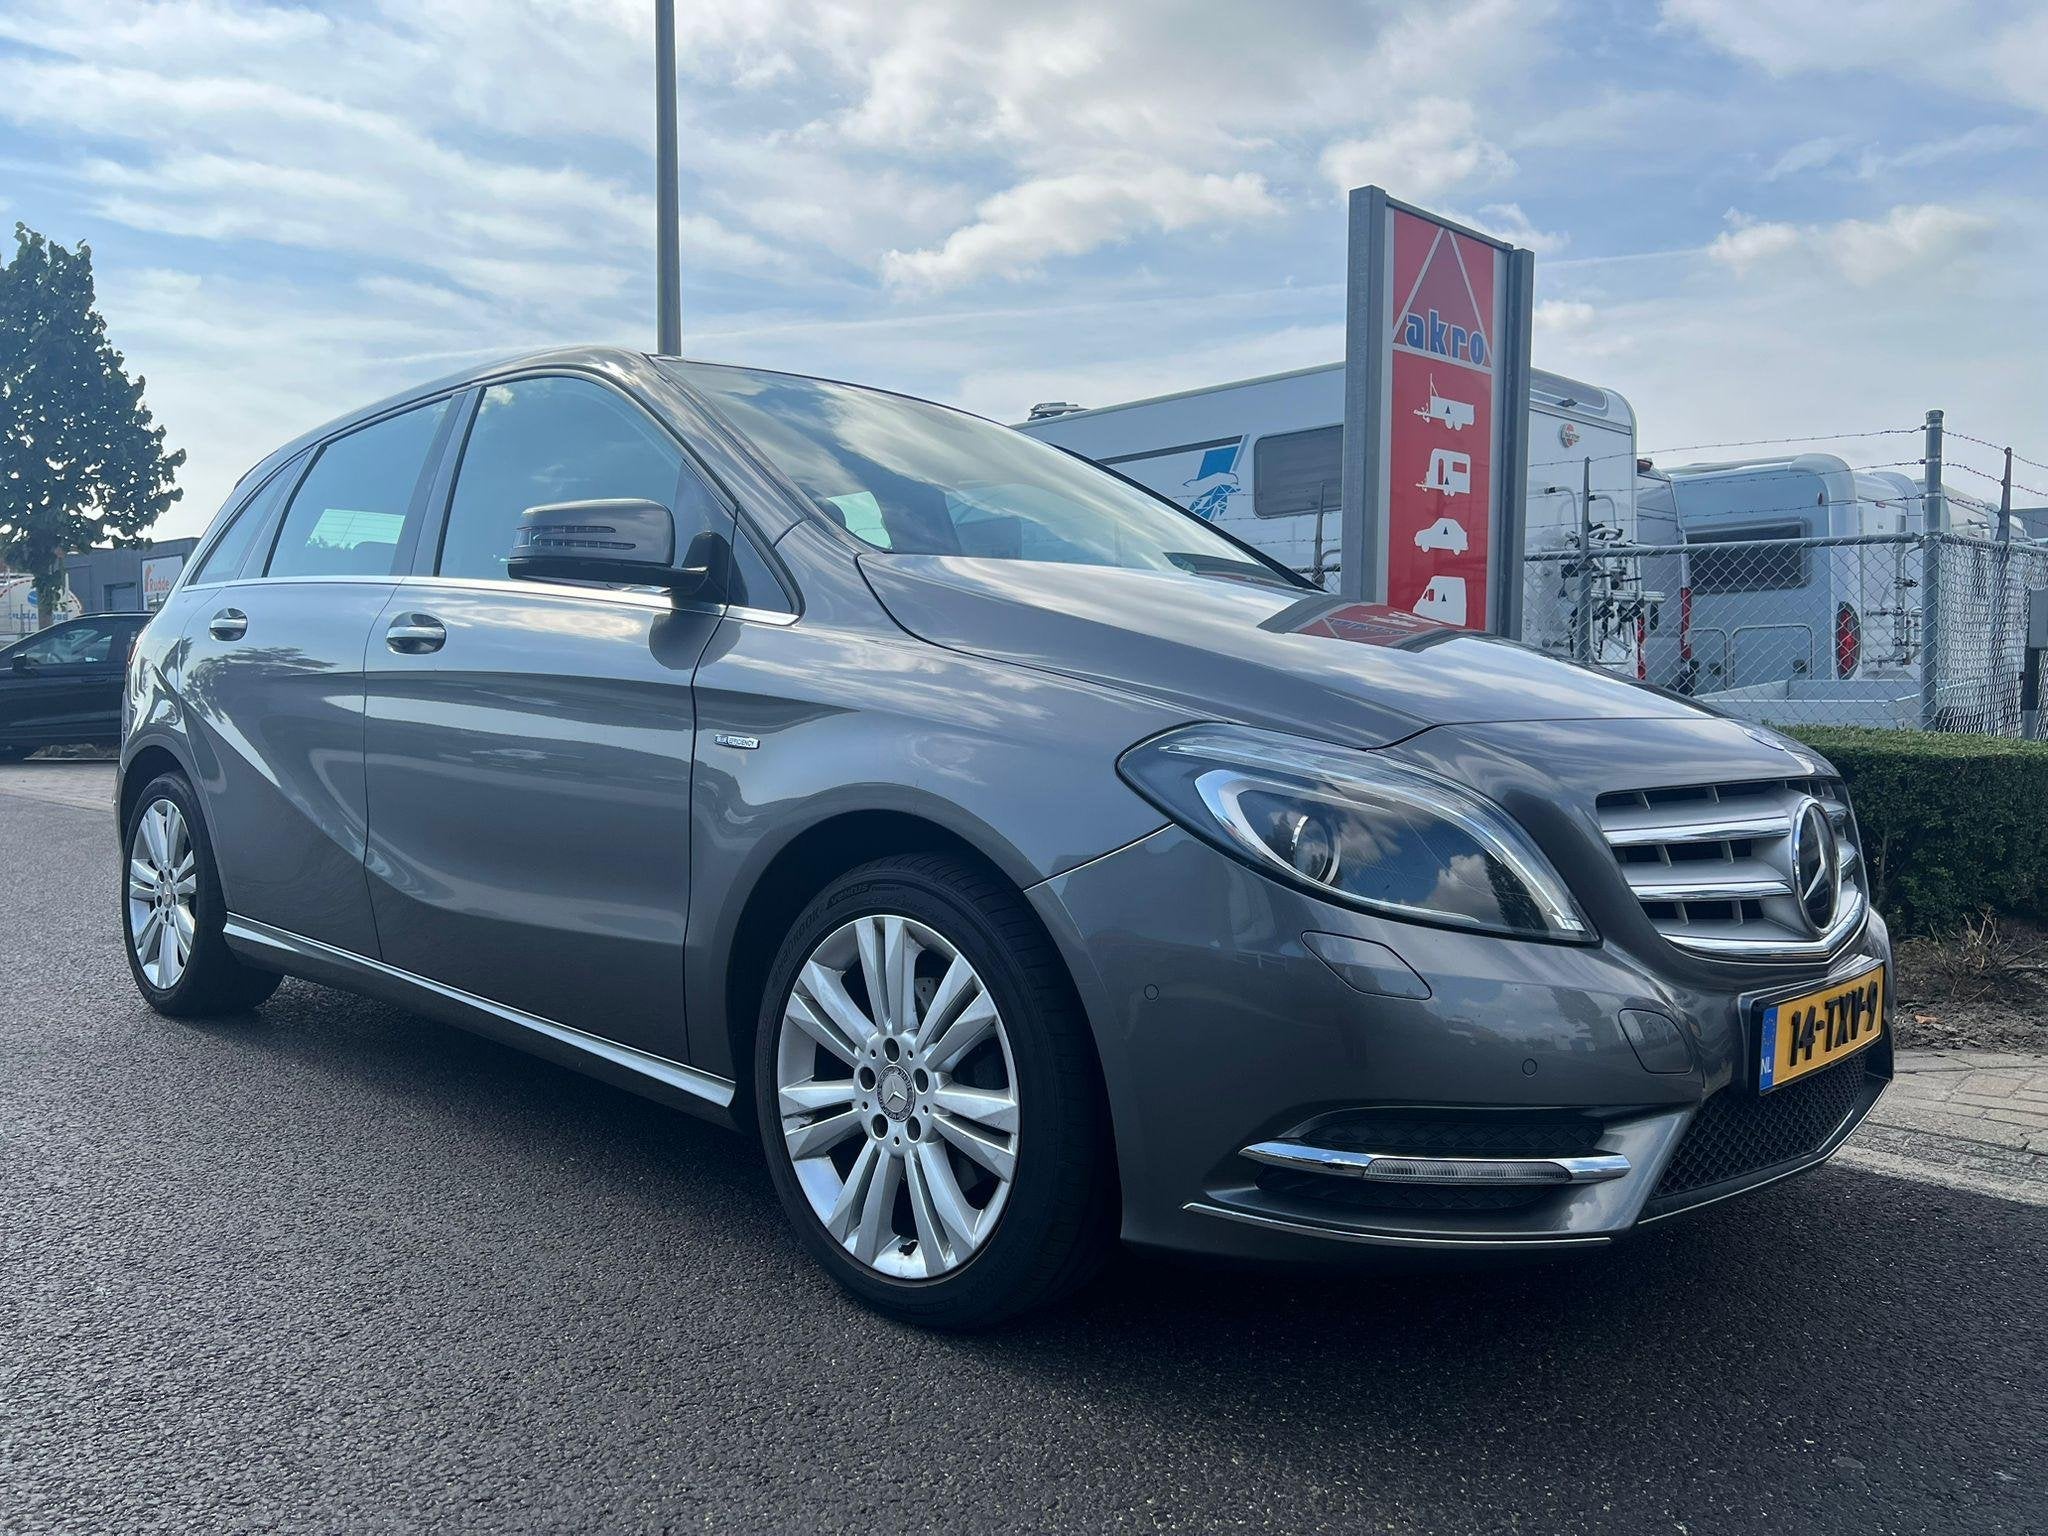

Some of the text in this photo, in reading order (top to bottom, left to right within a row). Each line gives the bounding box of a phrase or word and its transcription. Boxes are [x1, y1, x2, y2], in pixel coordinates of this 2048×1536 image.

[1404, 308, 1486, 367] akro
[1789, 980, 1878, 1067] 14-TXV-9
[1760, 1056, 1772, 1076] NL
